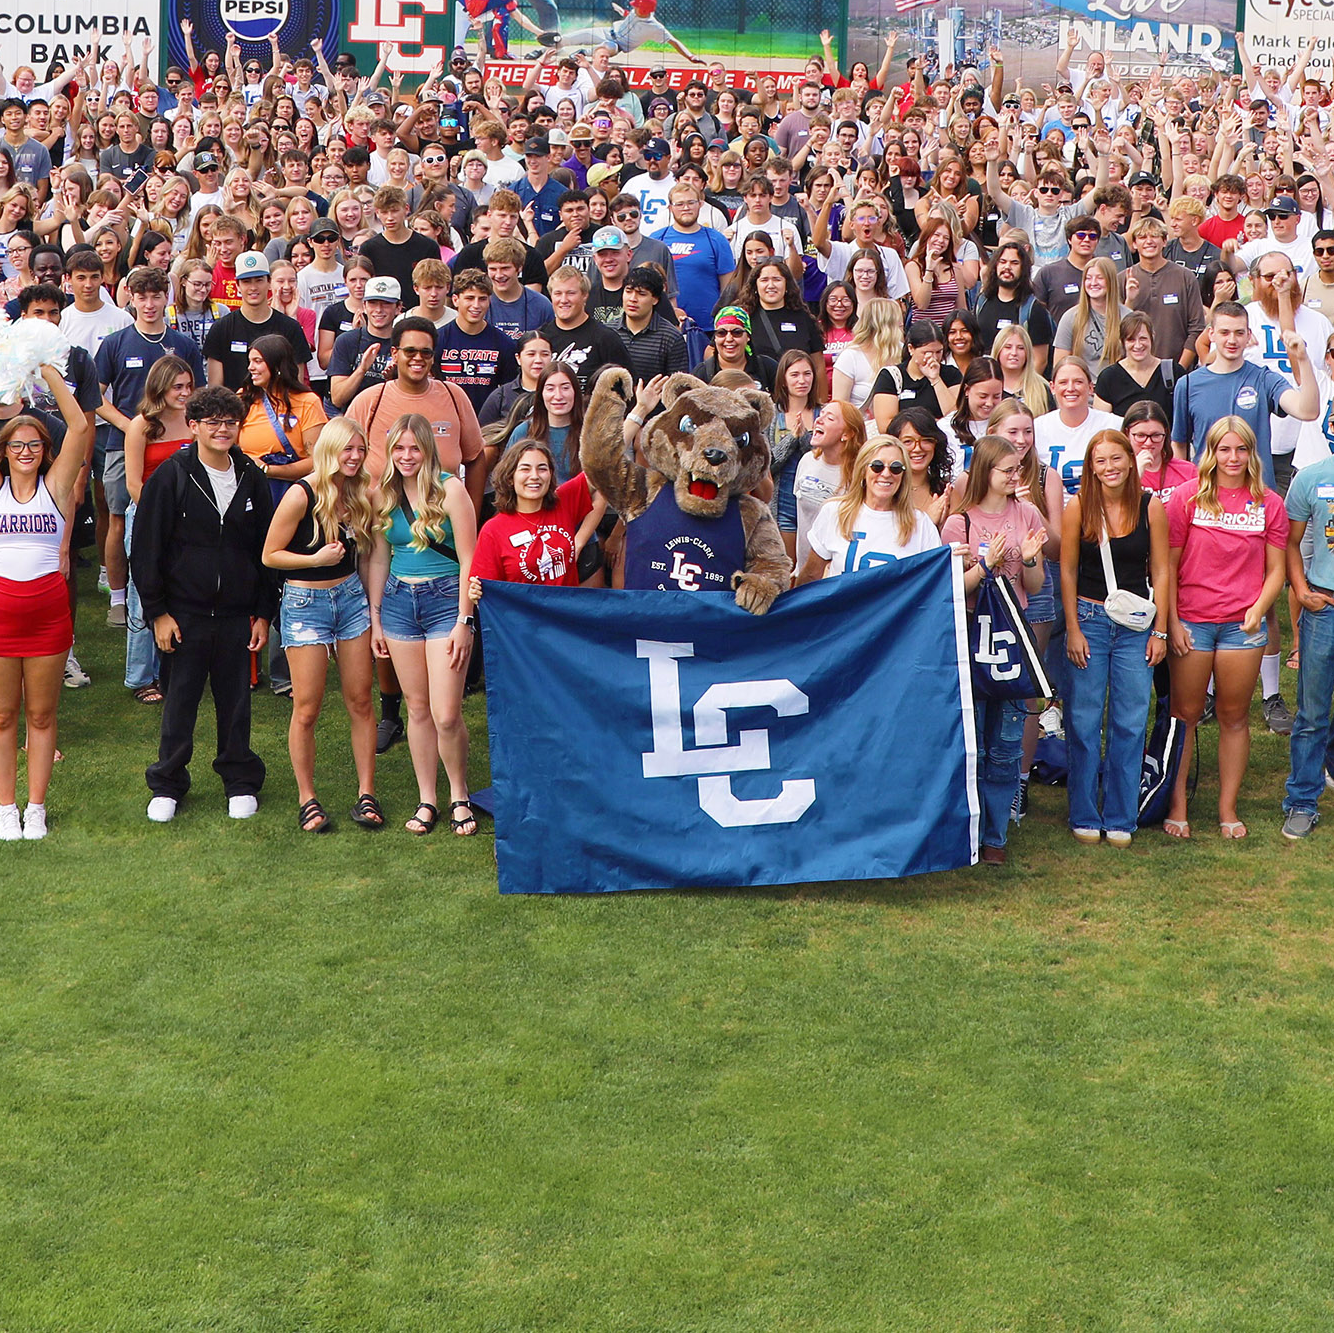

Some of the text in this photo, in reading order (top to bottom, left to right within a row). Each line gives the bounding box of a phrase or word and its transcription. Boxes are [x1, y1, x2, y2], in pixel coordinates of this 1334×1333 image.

[225, 0, 283, 15] PEPSI
[1059, 21, 1223, 54] INLAND
[1252, 35, 1291, 48] Mark
[1257, 54, 1296, 66] Chad
[670, 243, 695, 255] NIKE
[441, 349, 500, 361] LC STATE
[1195, 508, 1265, 527] WARRIORS
[665, 536, 715, 559] LEWIS-CLARK
[651, 561, 725, 583] EST. 1893
[669, 551, 703, 592] LC
[974, 614, 1022, 682] LC
[635, 638, 817, 829] LC
